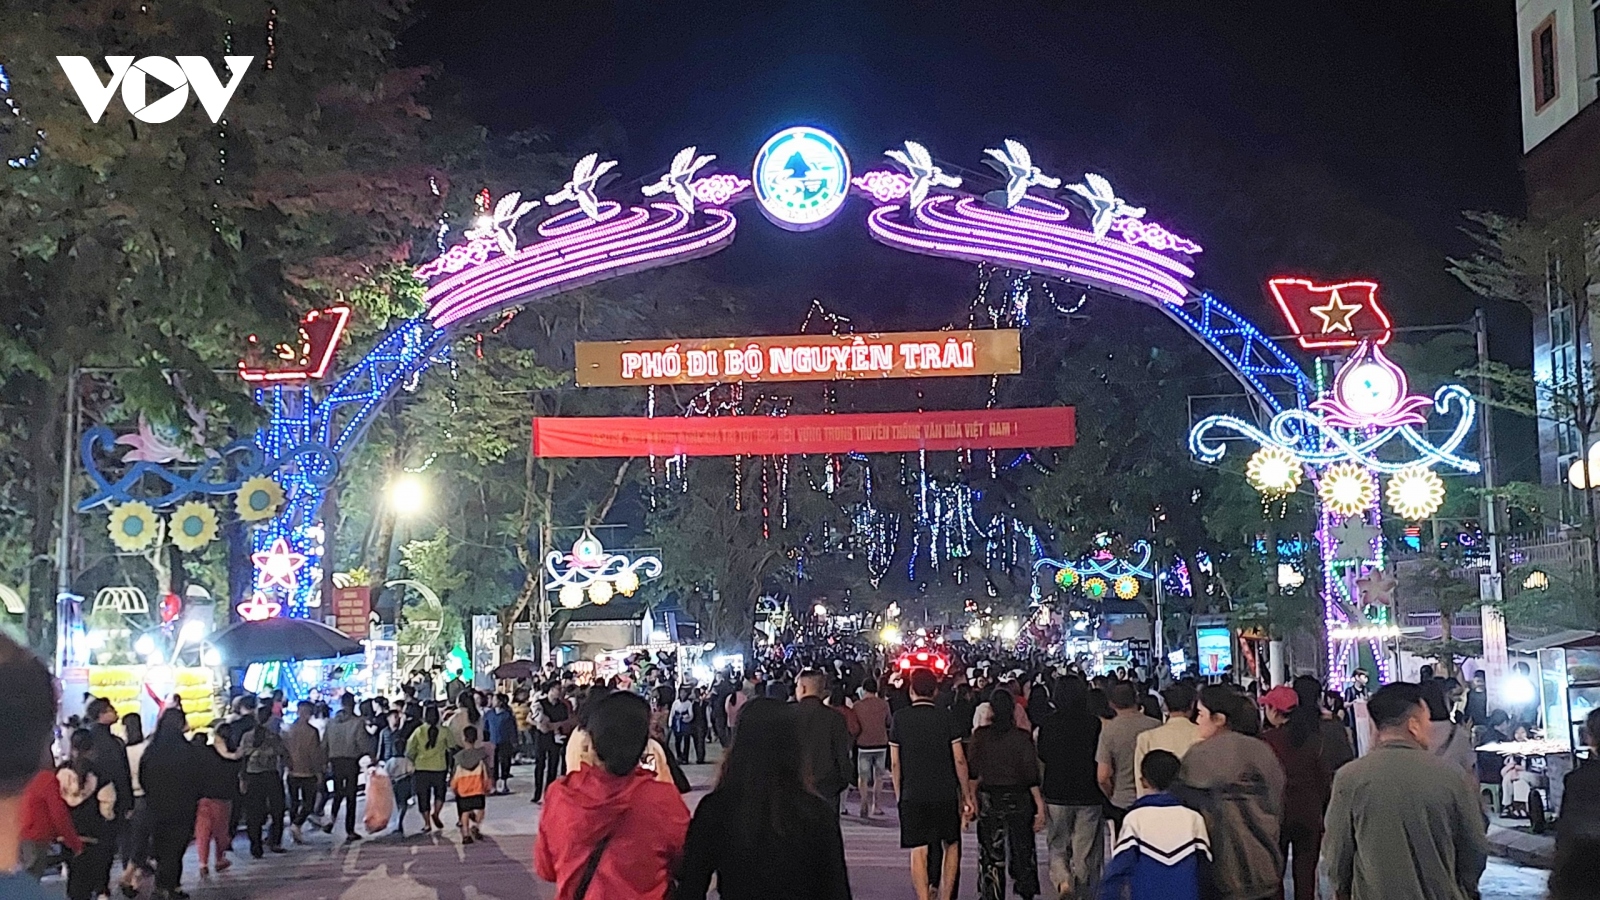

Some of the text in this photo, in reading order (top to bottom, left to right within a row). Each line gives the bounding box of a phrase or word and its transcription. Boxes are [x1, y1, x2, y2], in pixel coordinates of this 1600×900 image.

[622, 336, 974, 378] PHỐ ĐI BỘ NGUYỄN TRÃI
[823, 426, 853, 441] TRONG
[855, 423, 890, 440] TRUYỀN
[891, 421, 920, 439] THỐNG
[923, 422, 942, 438] VĂN
[944, 420, 962, 438] HÓA
[964, 421, 983, 440] VIỆT
[989, 422, 1010, 437] NAM
